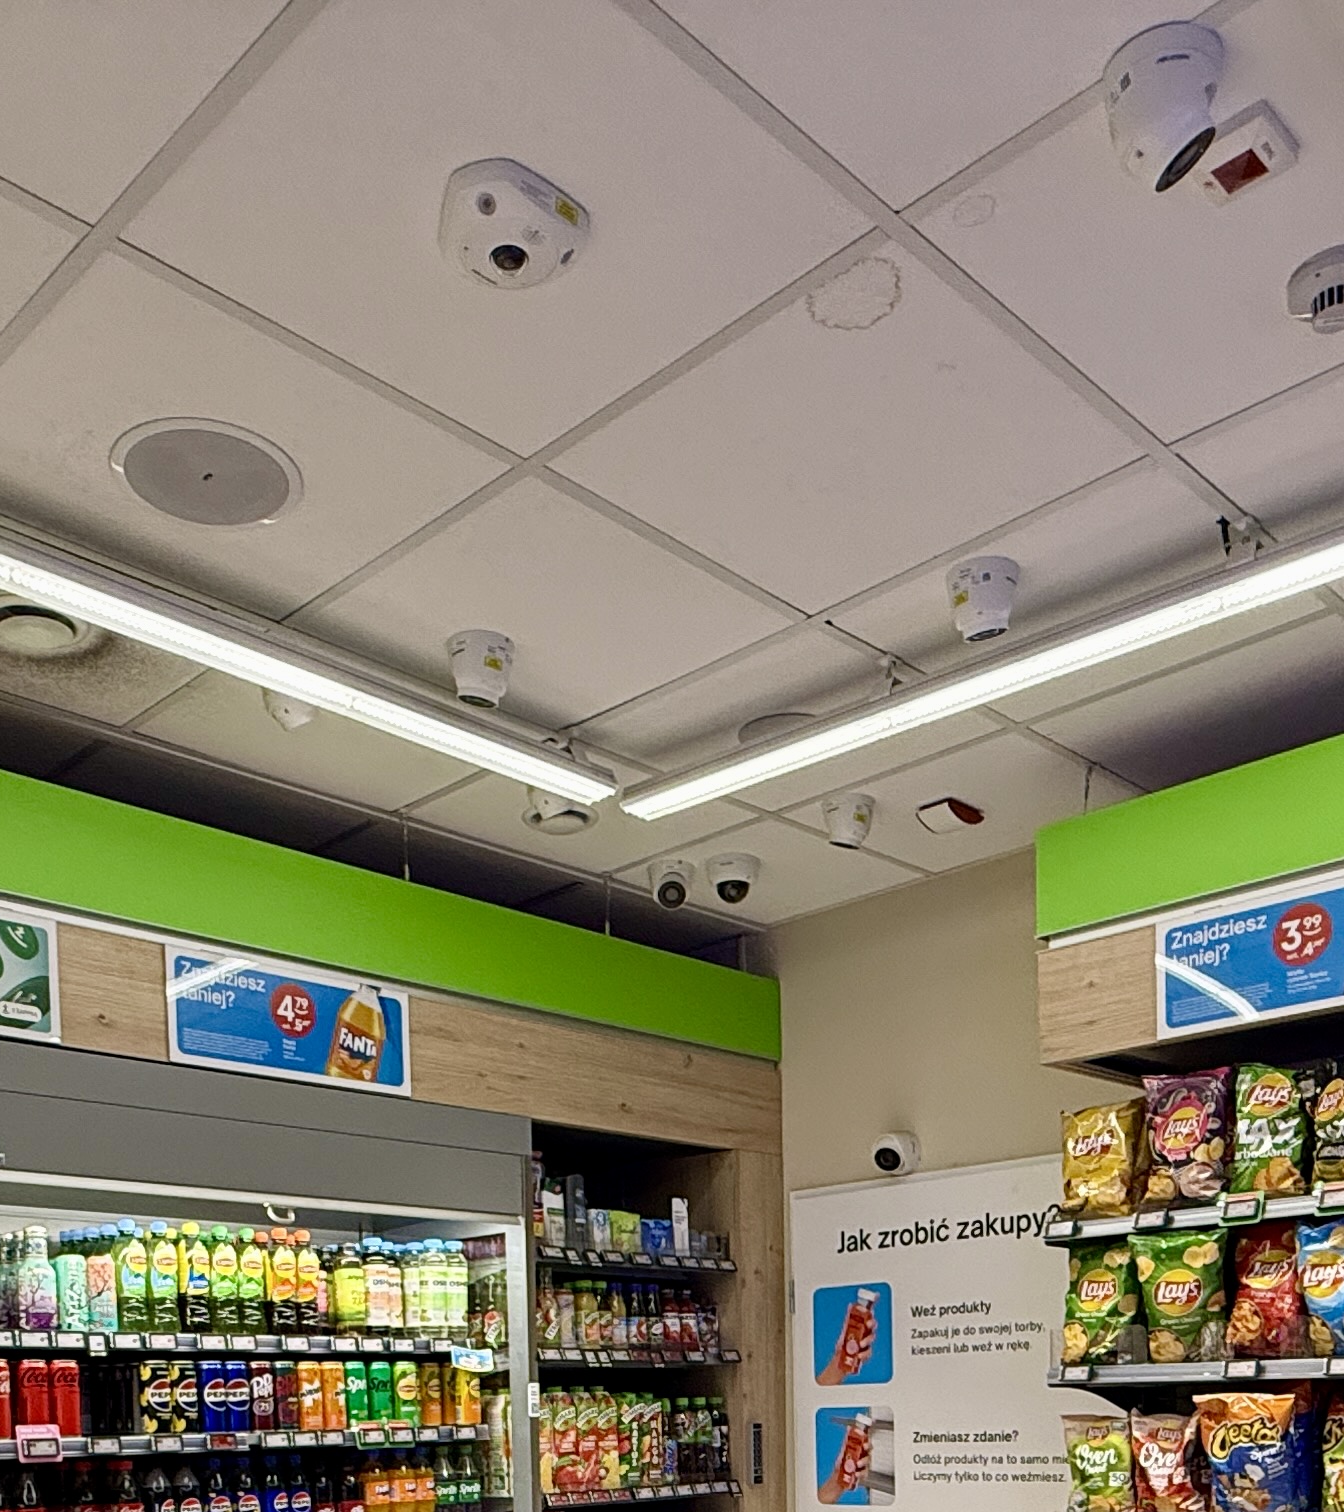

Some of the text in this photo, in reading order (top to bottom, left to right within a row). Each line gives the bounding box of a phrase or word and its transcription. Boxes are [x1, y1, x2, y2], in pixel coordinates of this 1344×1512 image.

[1171, 914, 1267, 950] Znajdziesz
[1280, 913, 1323, 952] 3 99
[1171, 943, 1230, 969] taniej?
[276, 994, 295, 1022] 4
[837, 1229, 872, 1254] Jak
[878, 1218, 950, 1249] zrobić
[910, 1301, 991, 1318] Weź produkty
[911, 1326, 949, 1340] Zapakuj
[951, 1326, 961, 1339] je
[963, 1325, 976, 1336] do
[978, 1323, 1012, 1336] swojej
[911, 1344, 951, 1356] kieszeni
[953, 1342, 969, 1353] lub
[971, 1340, 993, 1352] weź
[995, 1343, 1004, 1351] w
[913, 1430, 1019, 1443] Zmieniasz zdanie?
[913, 1453, 942, 1465] Odłóż
[944, 1453, 989, 1466] produkty
[991, 1456, 1004, 1464] na
[1007, 1454, 1017, 1464] to
[1020, 1455, 1049, 1464] samo
[913, 1471, 953, 1484] Liczymy
[955, 1471, 979, 1484] tylko
[982, 1471, 993, 1482] to
[995, 1473, 1008, 1482] co
